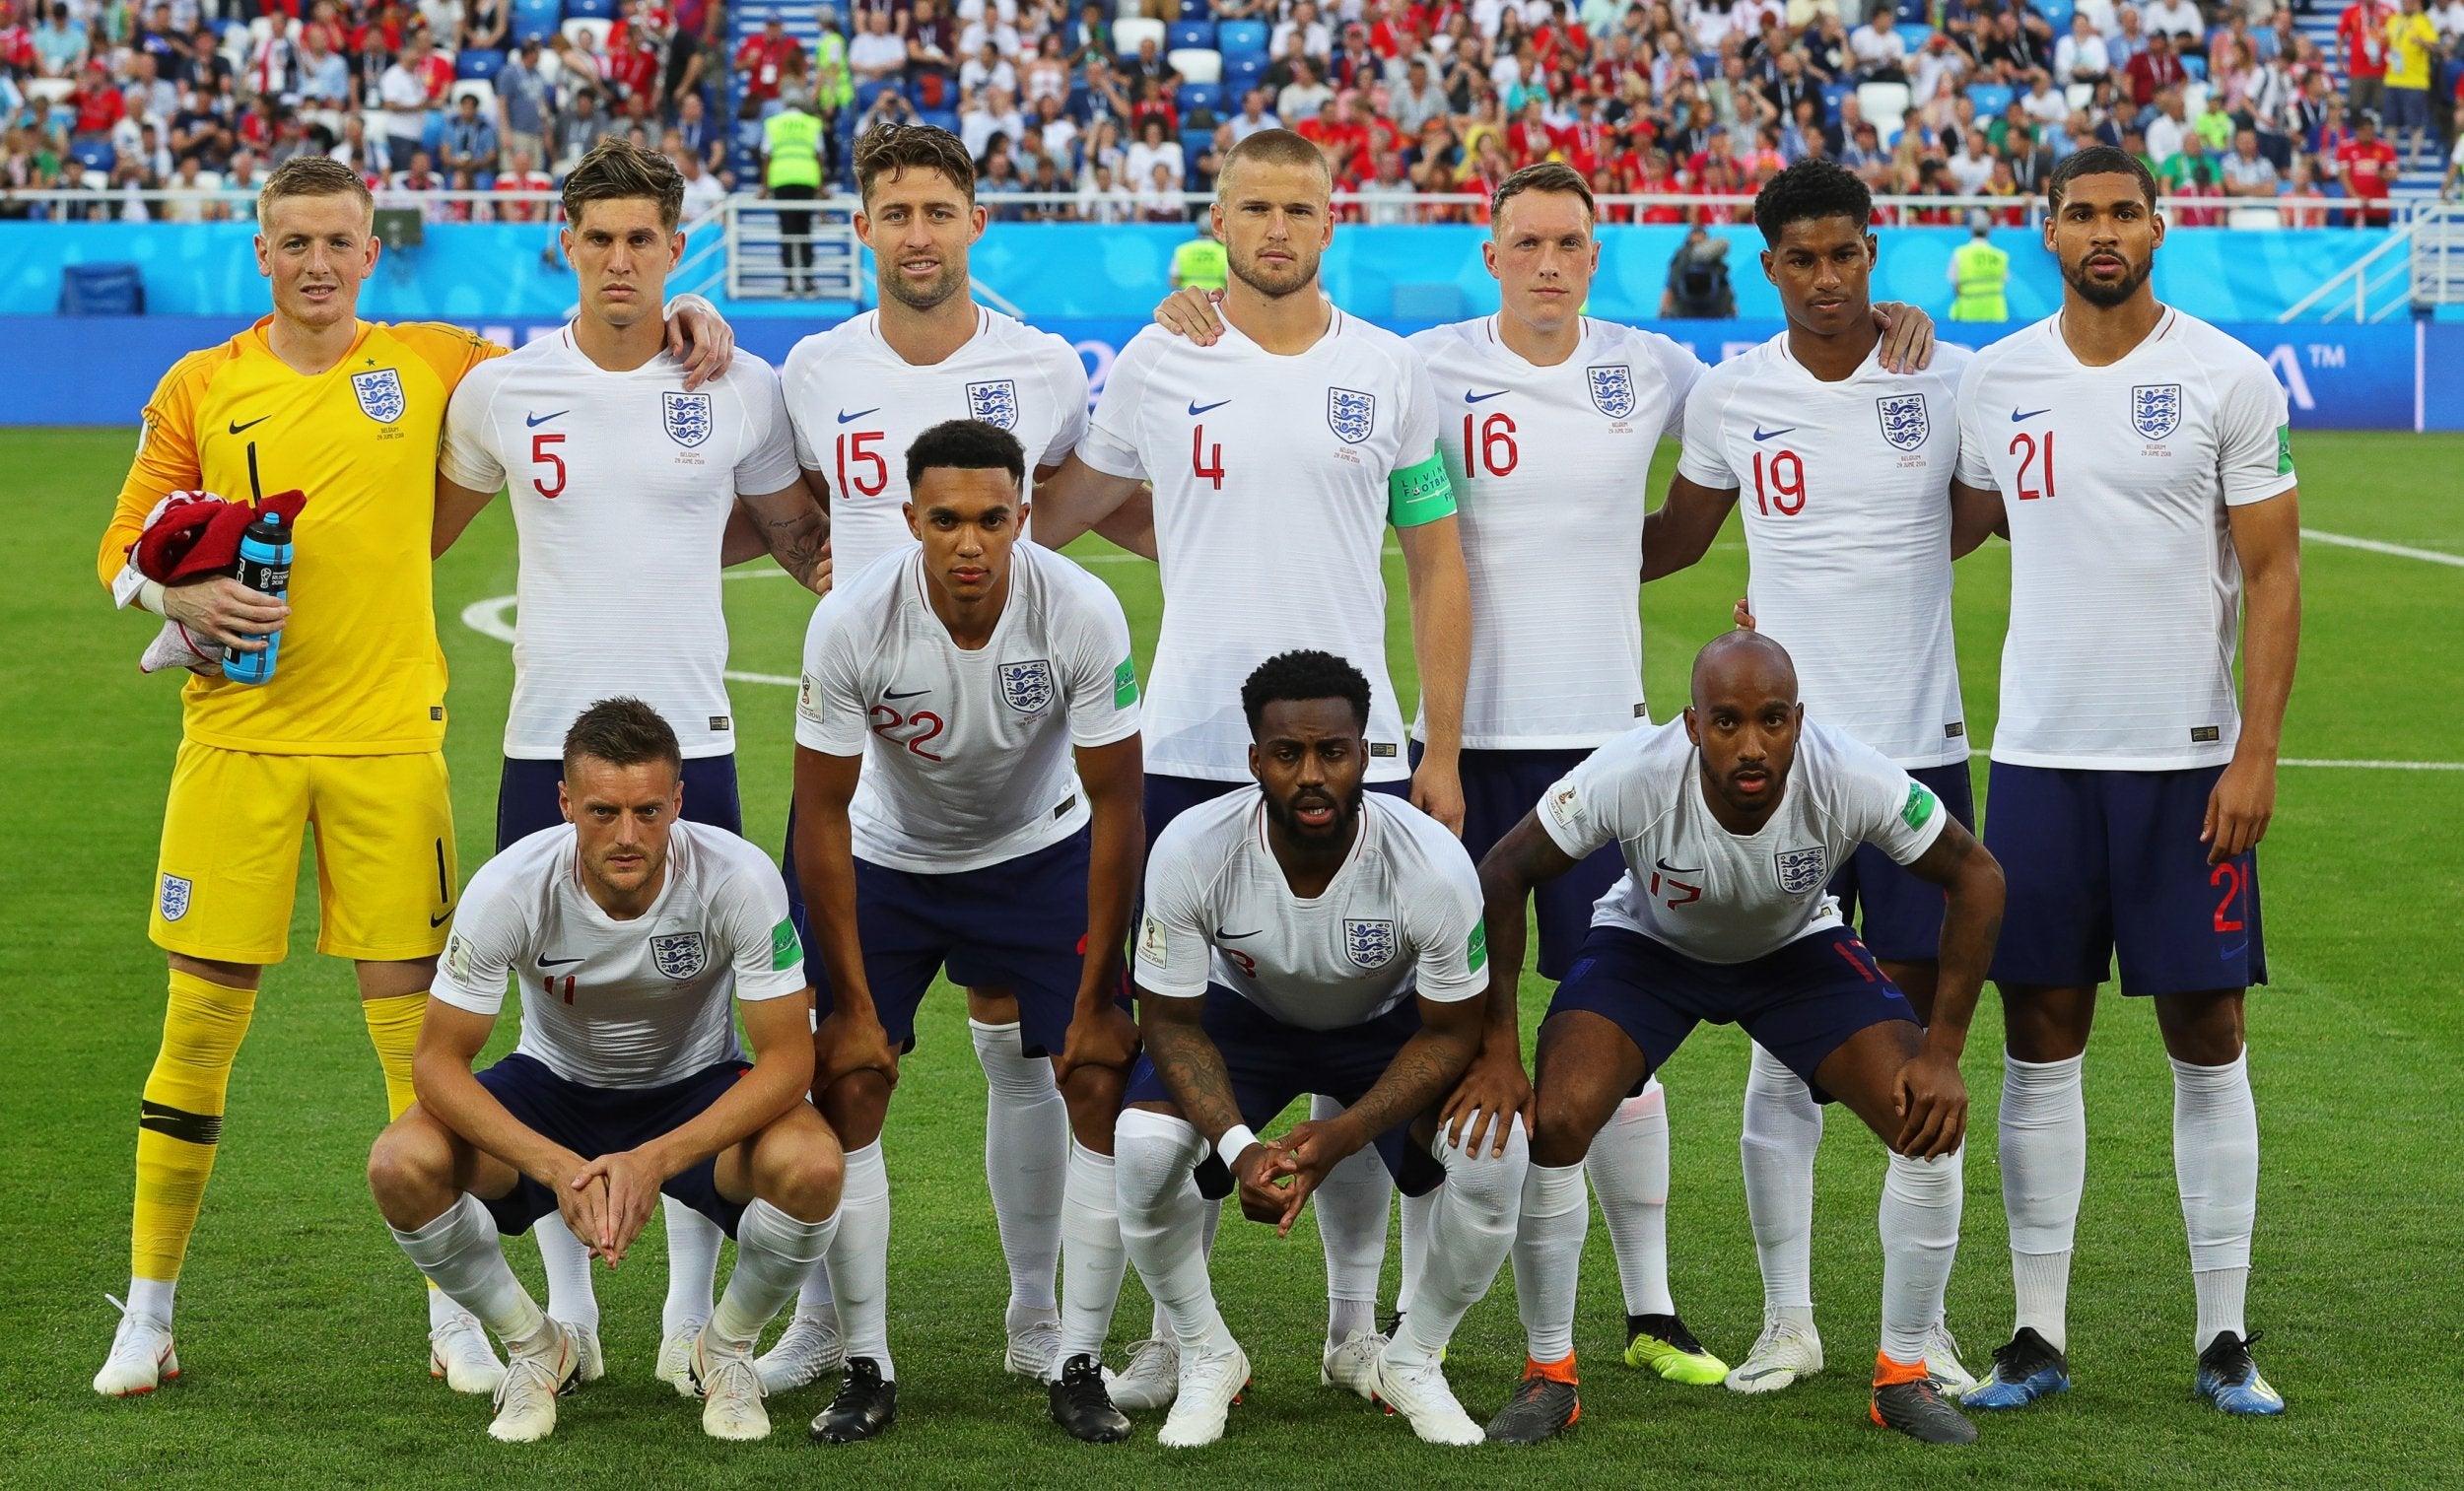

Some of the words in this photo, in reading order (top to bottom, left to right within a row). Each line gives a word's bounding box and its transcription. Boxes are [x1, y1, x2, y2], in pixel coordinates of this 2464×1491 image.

[246, 441, 262, 508] 1
[532, 434, 567, 500] 5
[836, 431, 888, 500] 15
[1193, 424, 1225, 491] 4
[1402, 465, 1443, 487] LIVIN
[1463, 412, 1519, 479] 16
[2009, 431, 2056, 501] 21
[1752, 449, 1807, 516] 19
[868, 705, 944, 762] 22
[436, 836, 448, 904] 1
[1650, 871, 1702, 911] 17
[543, 974, 576, 1006] 11
